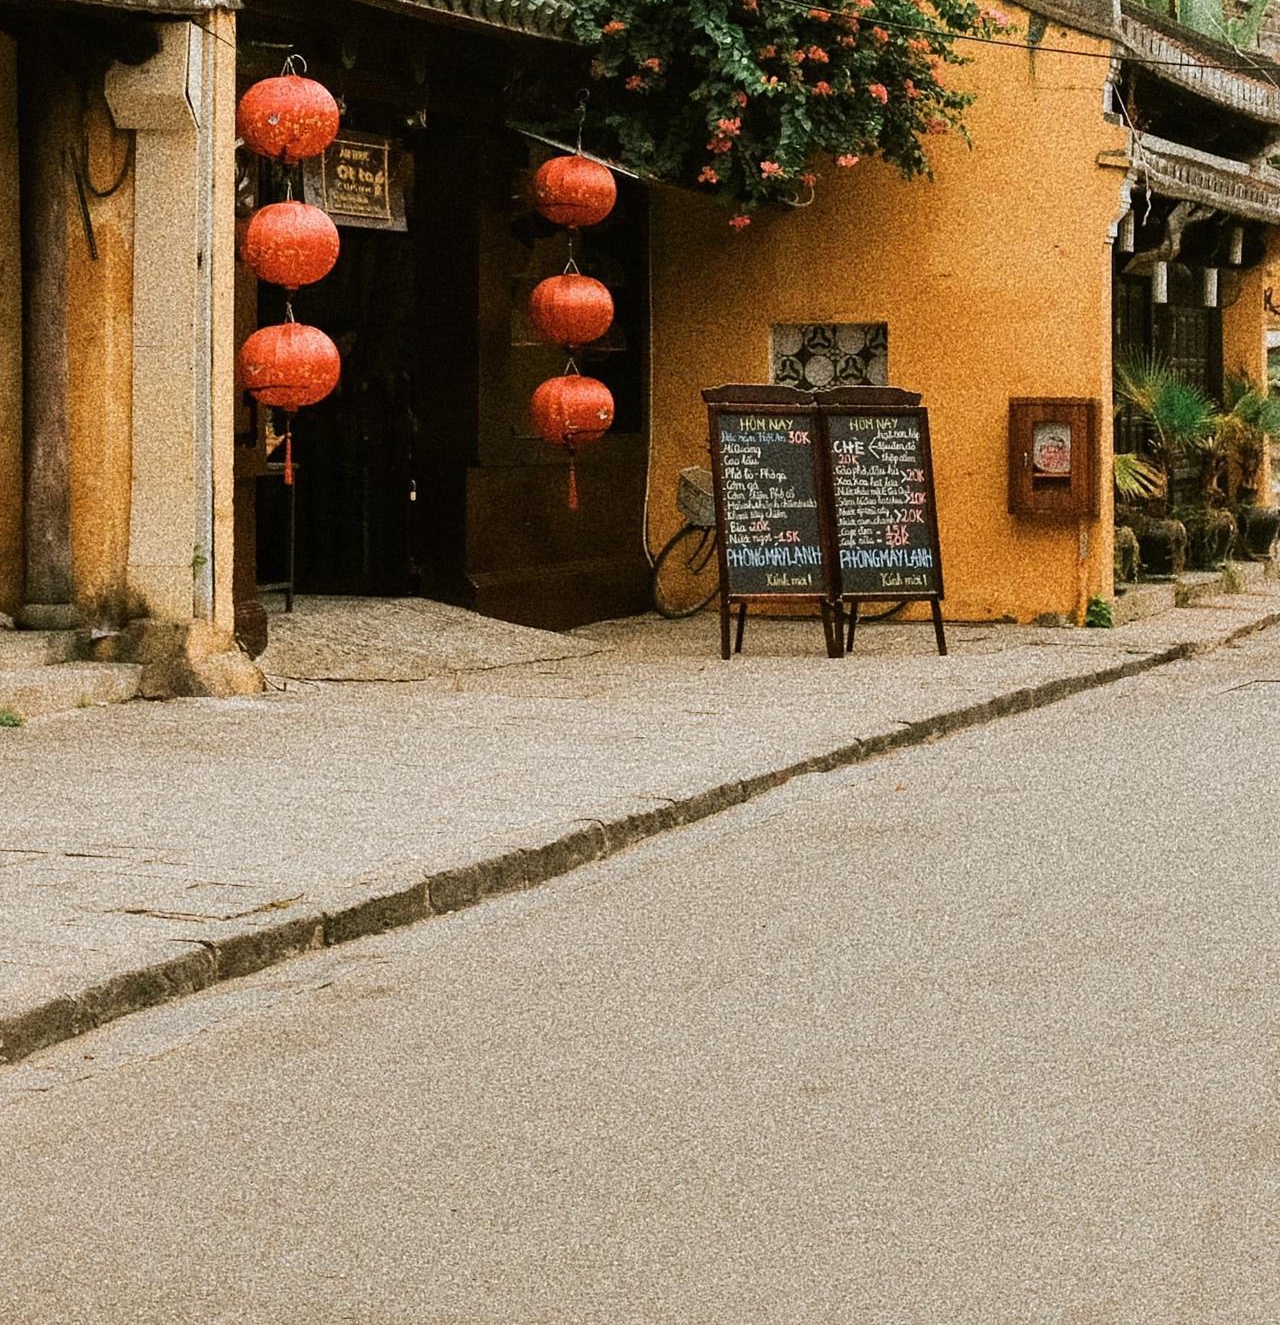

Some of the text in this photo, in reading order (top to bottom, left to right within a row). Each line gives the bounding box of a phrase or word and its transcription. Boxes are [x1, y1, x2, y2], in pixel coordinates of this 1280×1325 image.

[740, 415, 793, 430] HÔM NAY
[876, 418, 898, 430] NAY
[788, 431, 811, 444] 30K
[833, 436, 865, 455] CHÈ
[724, 455, 740, 465] Cao
[839, 454, 859, 464] 20K
[909, 492, 926, 504] 10K
[901, 508, 924, 523] 20K
[730, 521, 746, 533] Bia
[726, 544, 765, 568] PHÒNG
[839, 547, 880, 569] PHÒNG
